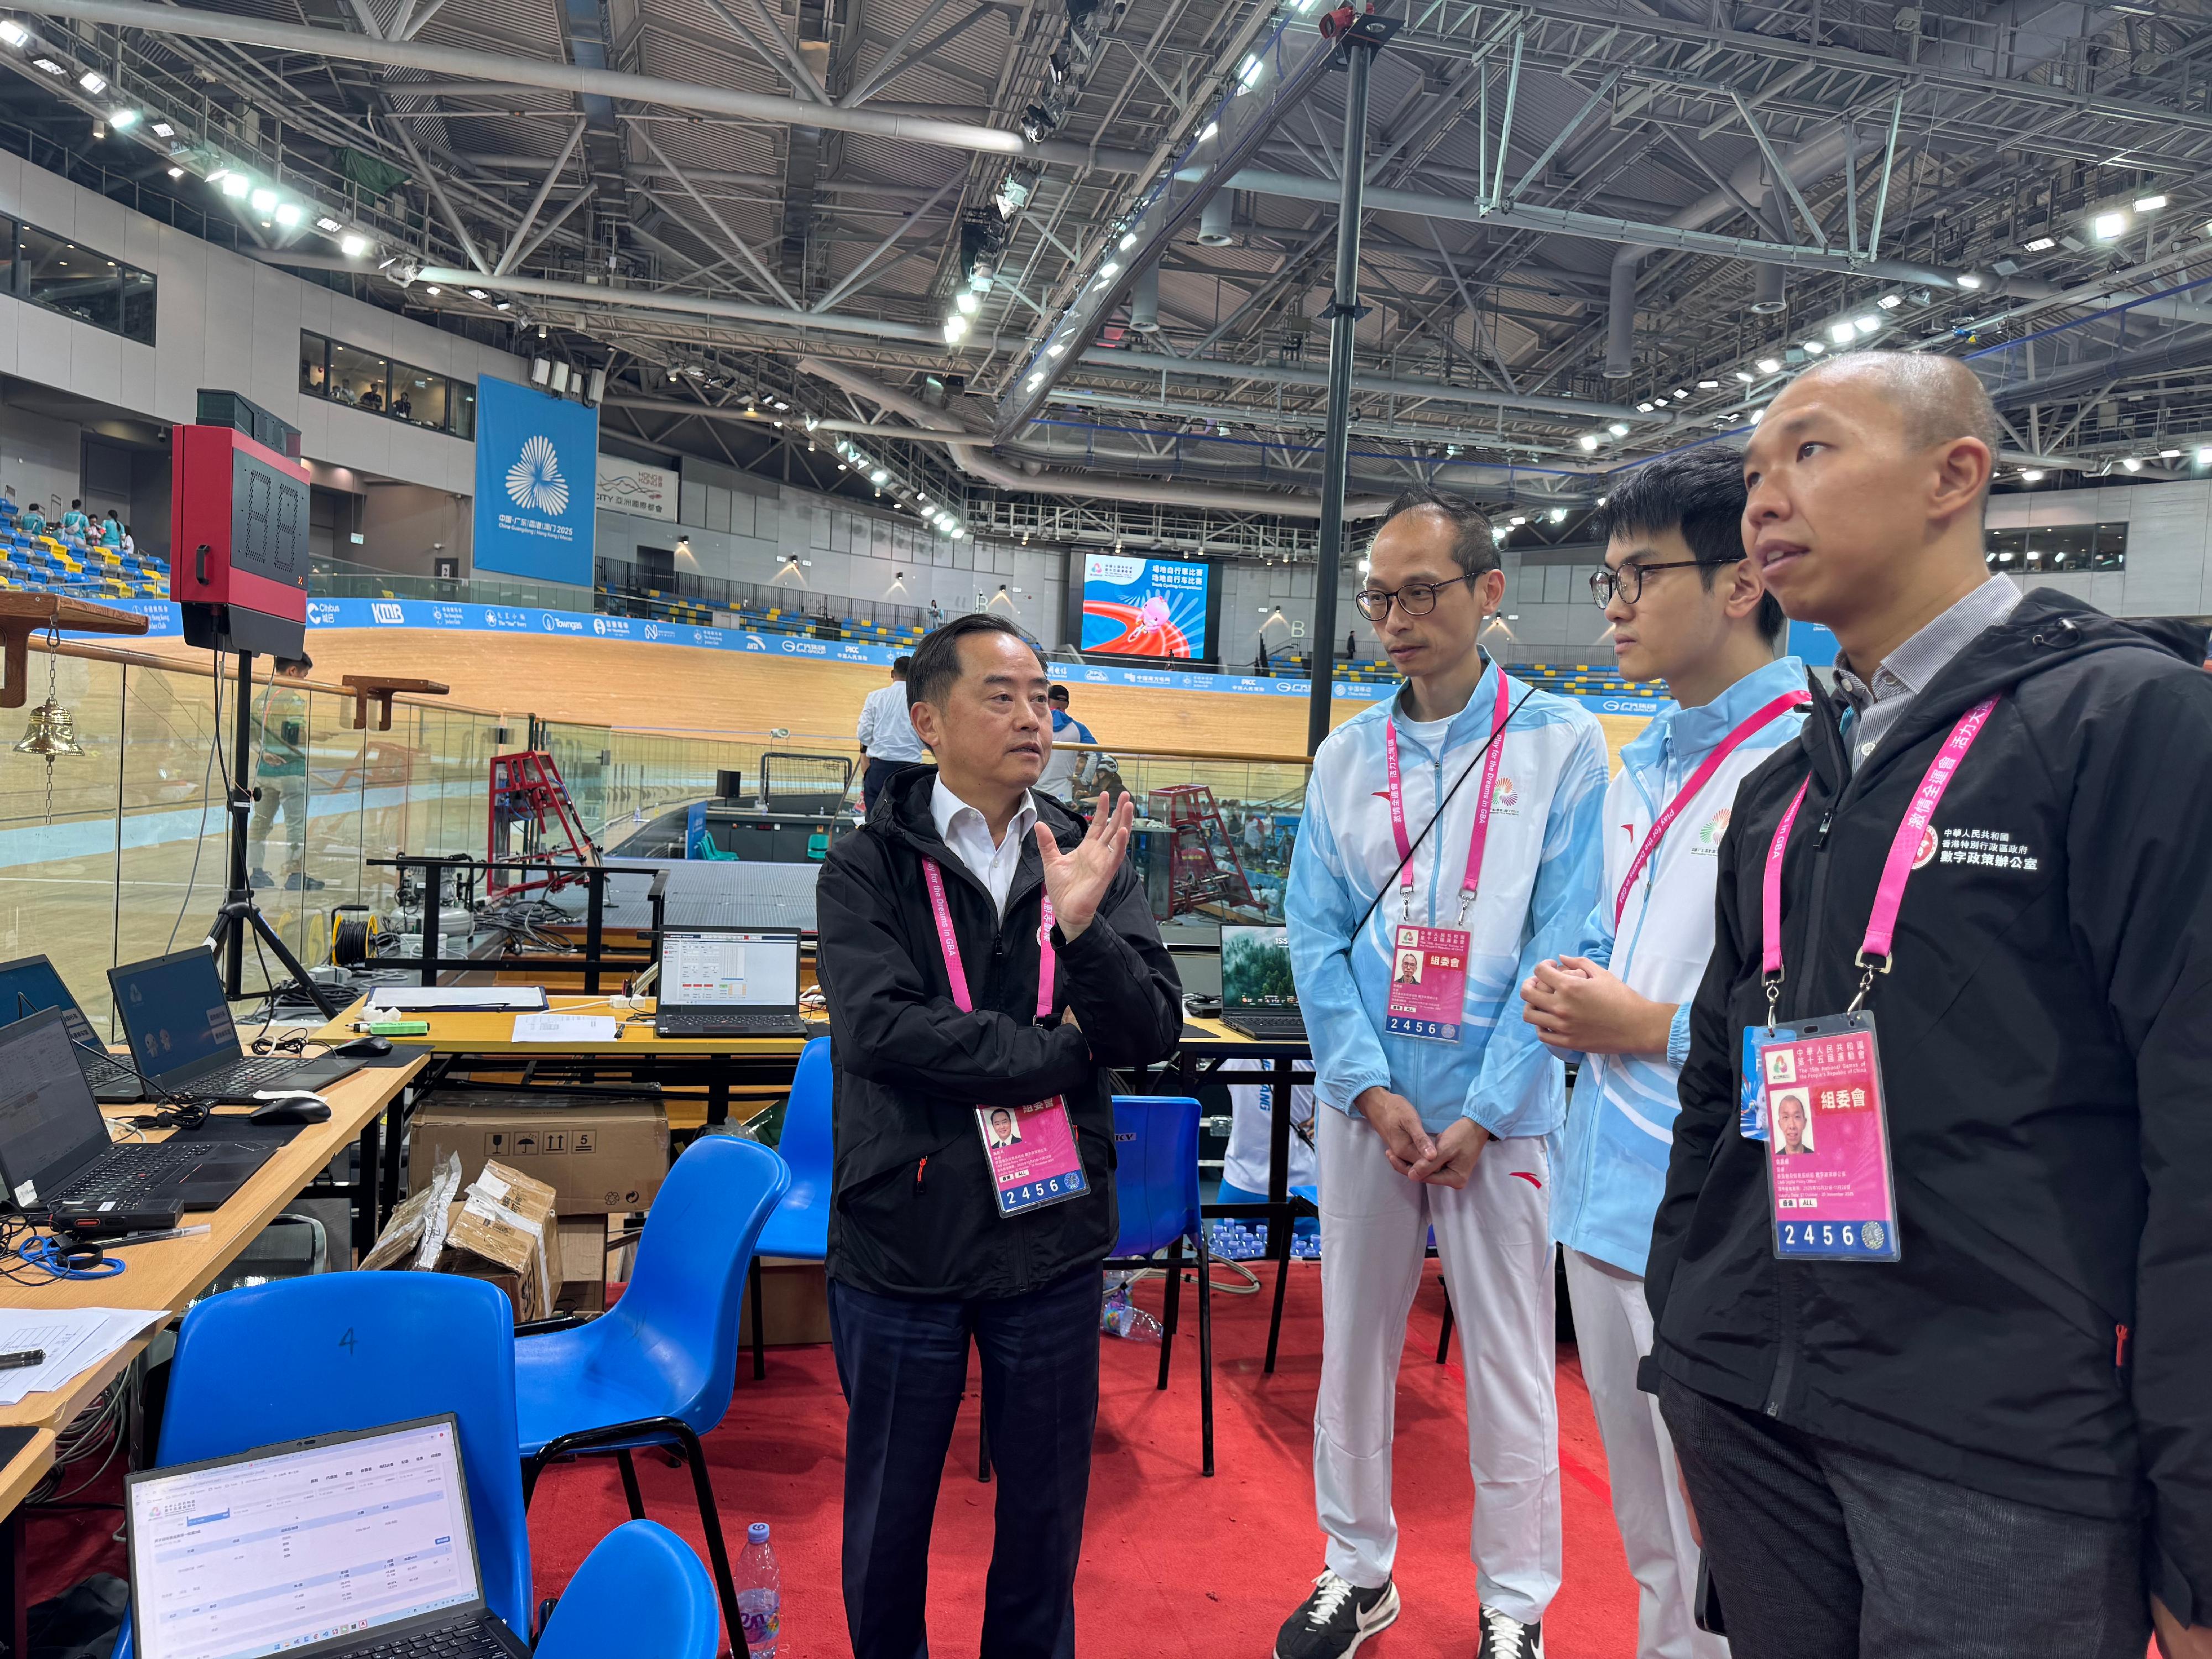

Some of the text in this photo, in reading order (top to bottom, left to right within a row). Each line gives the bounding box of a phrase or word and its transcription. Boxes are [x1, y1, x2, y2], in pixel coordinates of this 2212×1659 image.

[557, 525, 573, 536] 2025
[444, 567, 448, 577] 2
[320, 603, 340, 613] Citybus
[371, 603, 404, 624] KMB
[555, 618, 582, 630] Towngas
[1291, 620, 1305, 638] B
[1494, 734, 1502, 748] Play
[1488, 760, 1497, 771] the
[1483, 773, 1494, 799] Dreams
[1908, 756, 1957, 830] 激情全運會
[1479, 810, 1488, 824] GBA
[1661, 808, 1675, 827] Play
[1652, 826, 1662, 839] for
[1944, 828, 2009, 842] 中華人民共和國
[1644, 837, 1653, 851] the
[1772, 836, 1785, 859] GBA
[1942, 839, 2028, 854] 香港特別行政區政府
[927, 857, 935, 872] Play
[1629, 850, 1646, 879] Dreams
[1939, 851, 2038, 870] 數字政策辦公室
[933, 885, 941, 898] the
[936, 899, 948, 927] Dreams
[946, 938, 956, 957] GBA
[1430, 955, 1460, 968] 組委會
[1390, 1018, 1436, 1034] 2 4 5 6
[1796, 1040, 1864, 1056] 中華人民共和國
[1797, 1050, 1865, 1067] 第十五屆運動會
[1820, 1088, 1866, 1110] 組委會
[580, 1135, 588, 1145] 5
[1006, 1179, 1058, 1204] 2 4 5 6
[1785, 1224, 1854, 1245] 2 4 5 6
[338, 1327, 359, 1357] 4
